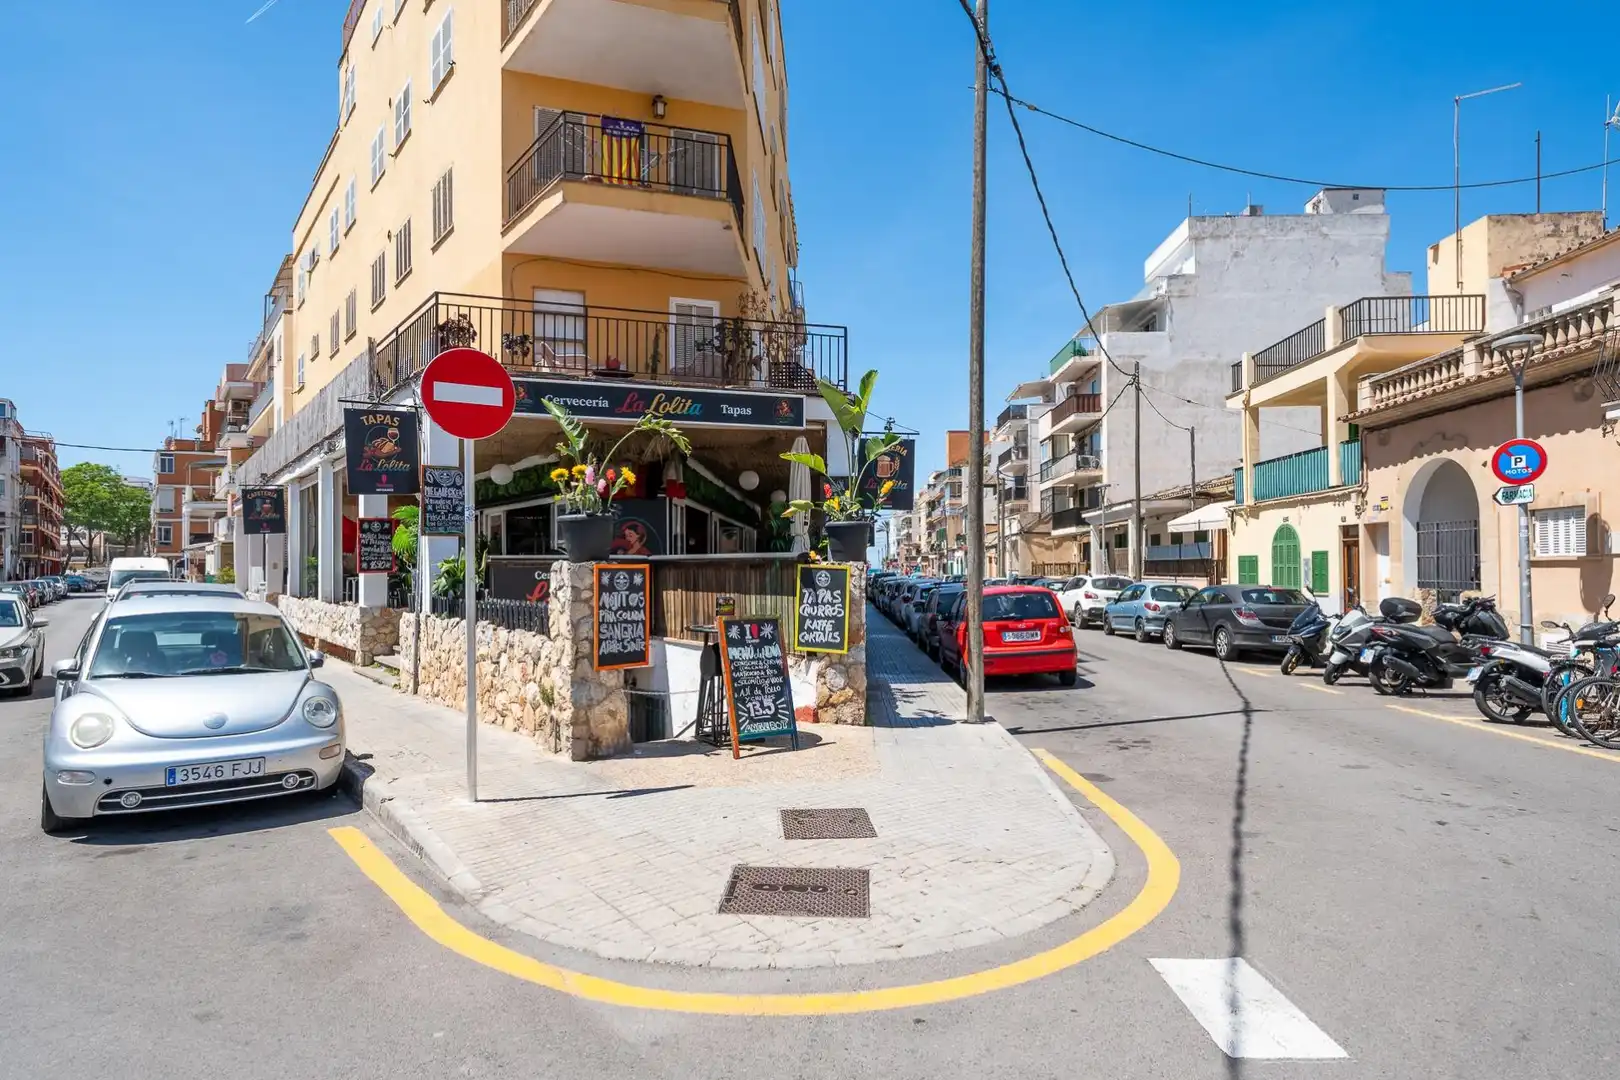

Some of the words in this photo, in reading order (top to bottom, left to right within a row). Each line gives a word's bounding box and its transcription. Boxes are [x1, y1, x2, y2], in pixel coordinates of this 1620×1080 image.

[544, 394, 609, 408] Cervecería
[615, 391, 643, 413] La
[644, 392, 703, 416] Lolita
[720, 404, 752, 416] Tapas
[360, 413, 400, 426] TAPAS
[356, 459, 373, 471] La
[374, 458, 412, 472] Lolita
[1514, 457, 1523, 466] P
[600, 591, 645, 611] MOJITOS
[802, 587, 842, 605] TAPAS
[599, 609, 616, 623] PIÑA
[616, 609, 645, 621] COLADA
[799, 603, 844, 617] CHURROS
[180, 765, 224, 782] 3546
[232, 761, 261, 777] FJJ
